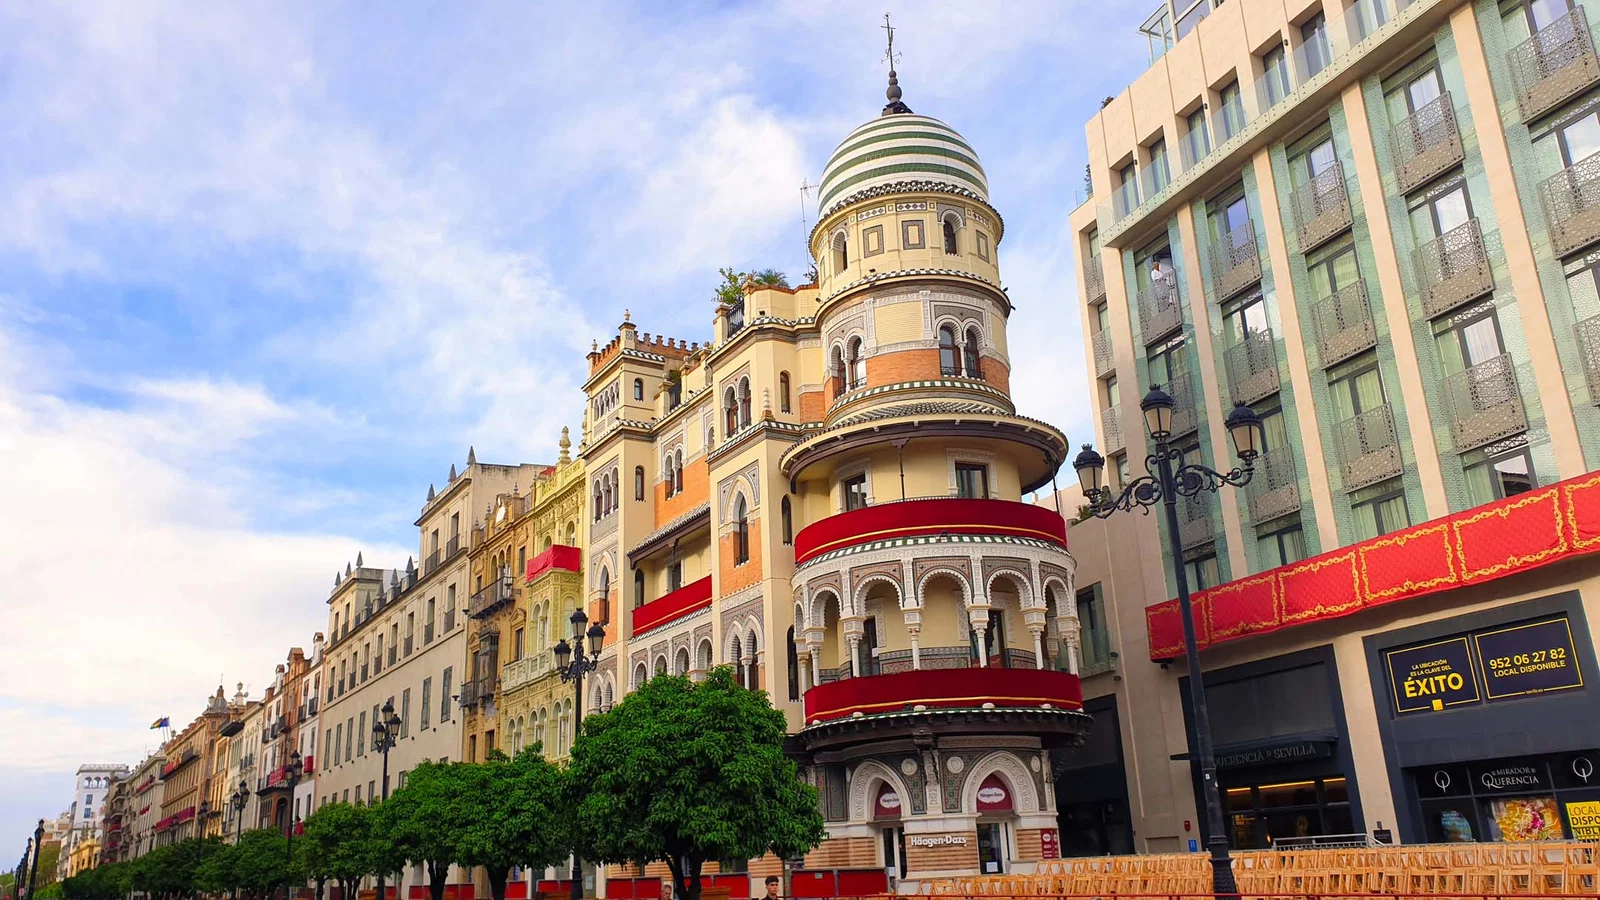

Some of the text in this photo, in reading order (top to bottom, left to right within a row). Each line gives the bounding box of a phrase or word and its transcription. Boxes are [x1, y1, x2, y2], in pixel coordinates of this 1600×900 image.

[1419, 659, 1447, 668] UBICACIÓN
[1489, 647, 1567, 670] 952 06 27 82
[1494, 660, 1566, 677] LOCAL DISPONIBLE
[1403, 672, 1464, 698] ÉXITO
[1273, 742, 1317, 759] SEVILLA
[1496, 766, 1531, 776] MIRADOR
[1481, 773, 1539, 789] QUERENCIA
[1569, 805, 1600, 816] LOCAL
[1573, 826, 1600, 836] NIBL
[911, 835, 967, 847] Häagen-Dazs
